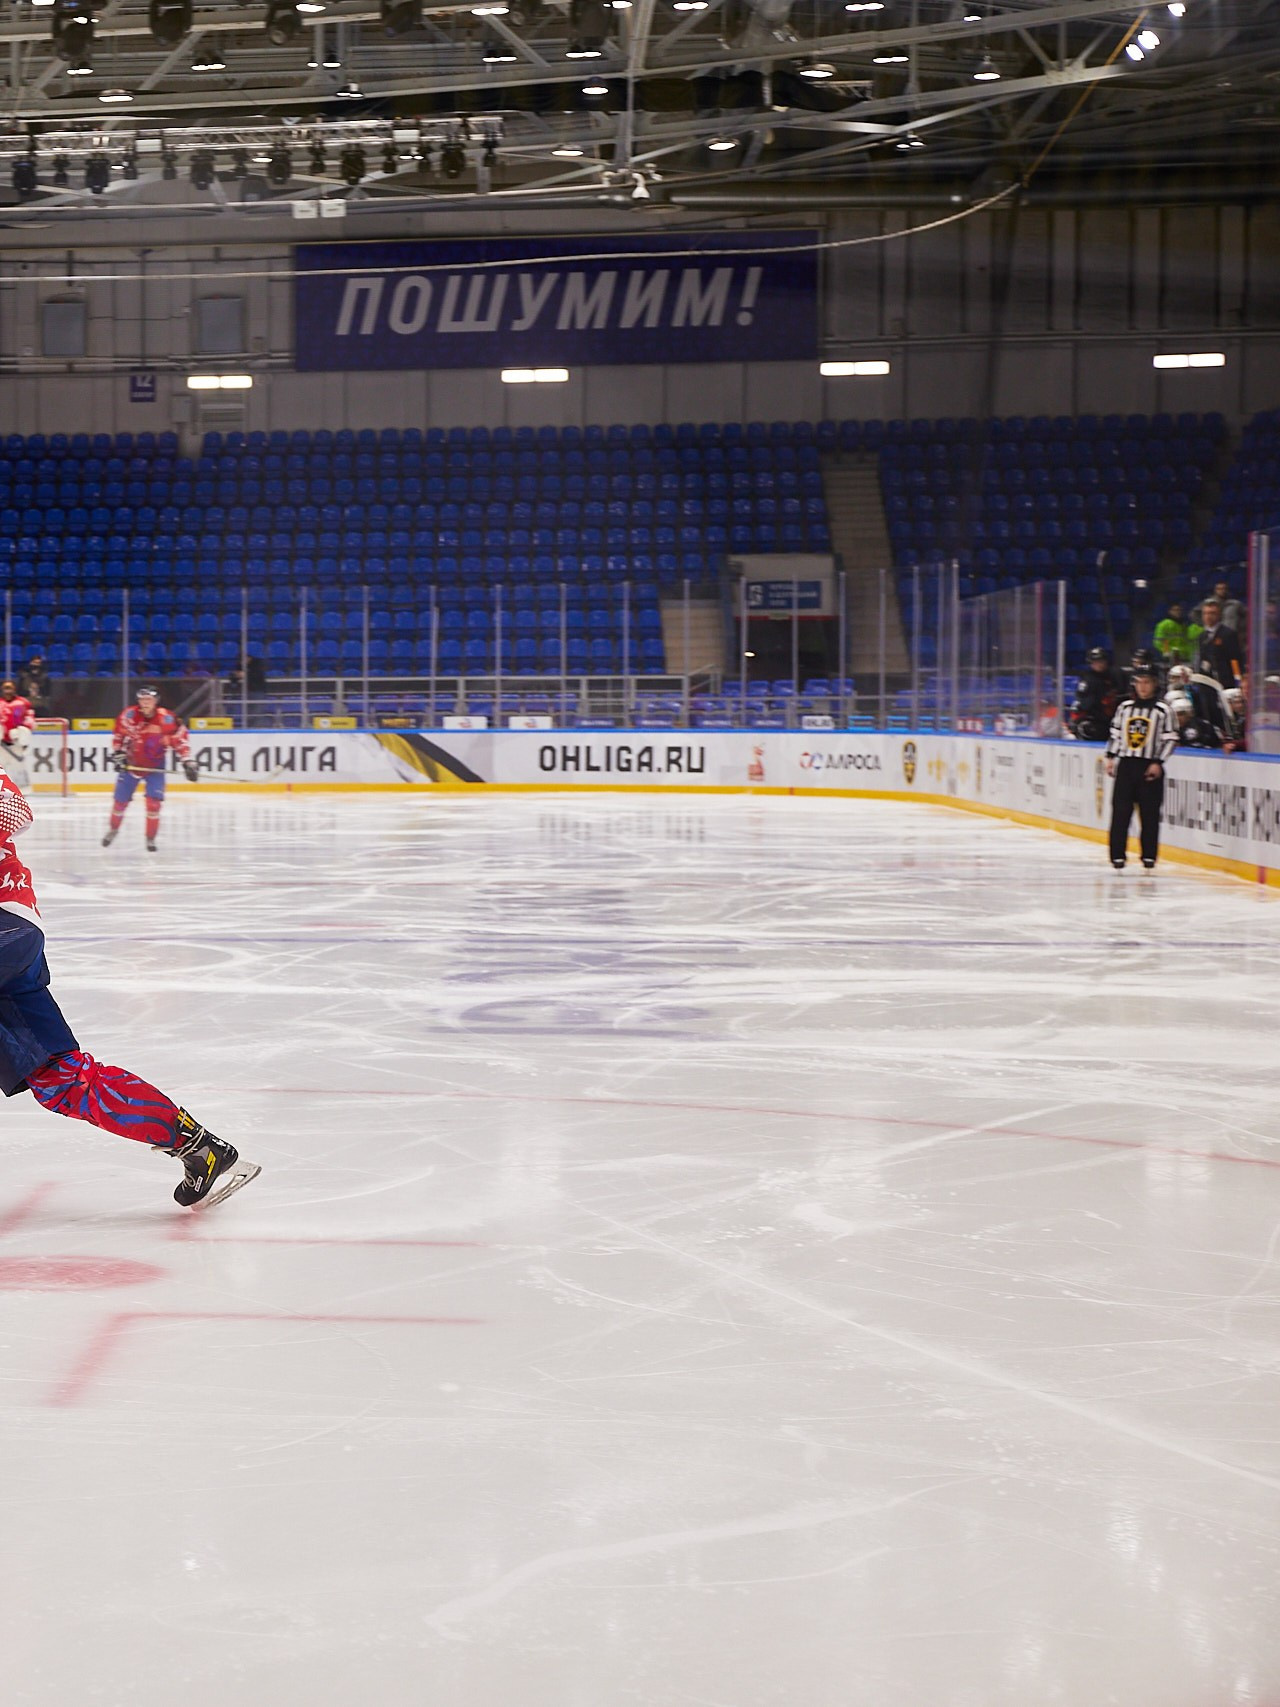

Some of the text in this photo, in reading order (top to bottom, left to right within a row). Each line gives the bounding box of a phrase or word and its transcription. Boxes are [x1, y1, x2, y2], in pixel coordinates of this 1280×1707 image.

[335, 266, 763, 336] ПОШУМИМ!
[251, 746, 337, 772] ЛИГА
[539, 745, 705, 773] OHLIGA.RU
